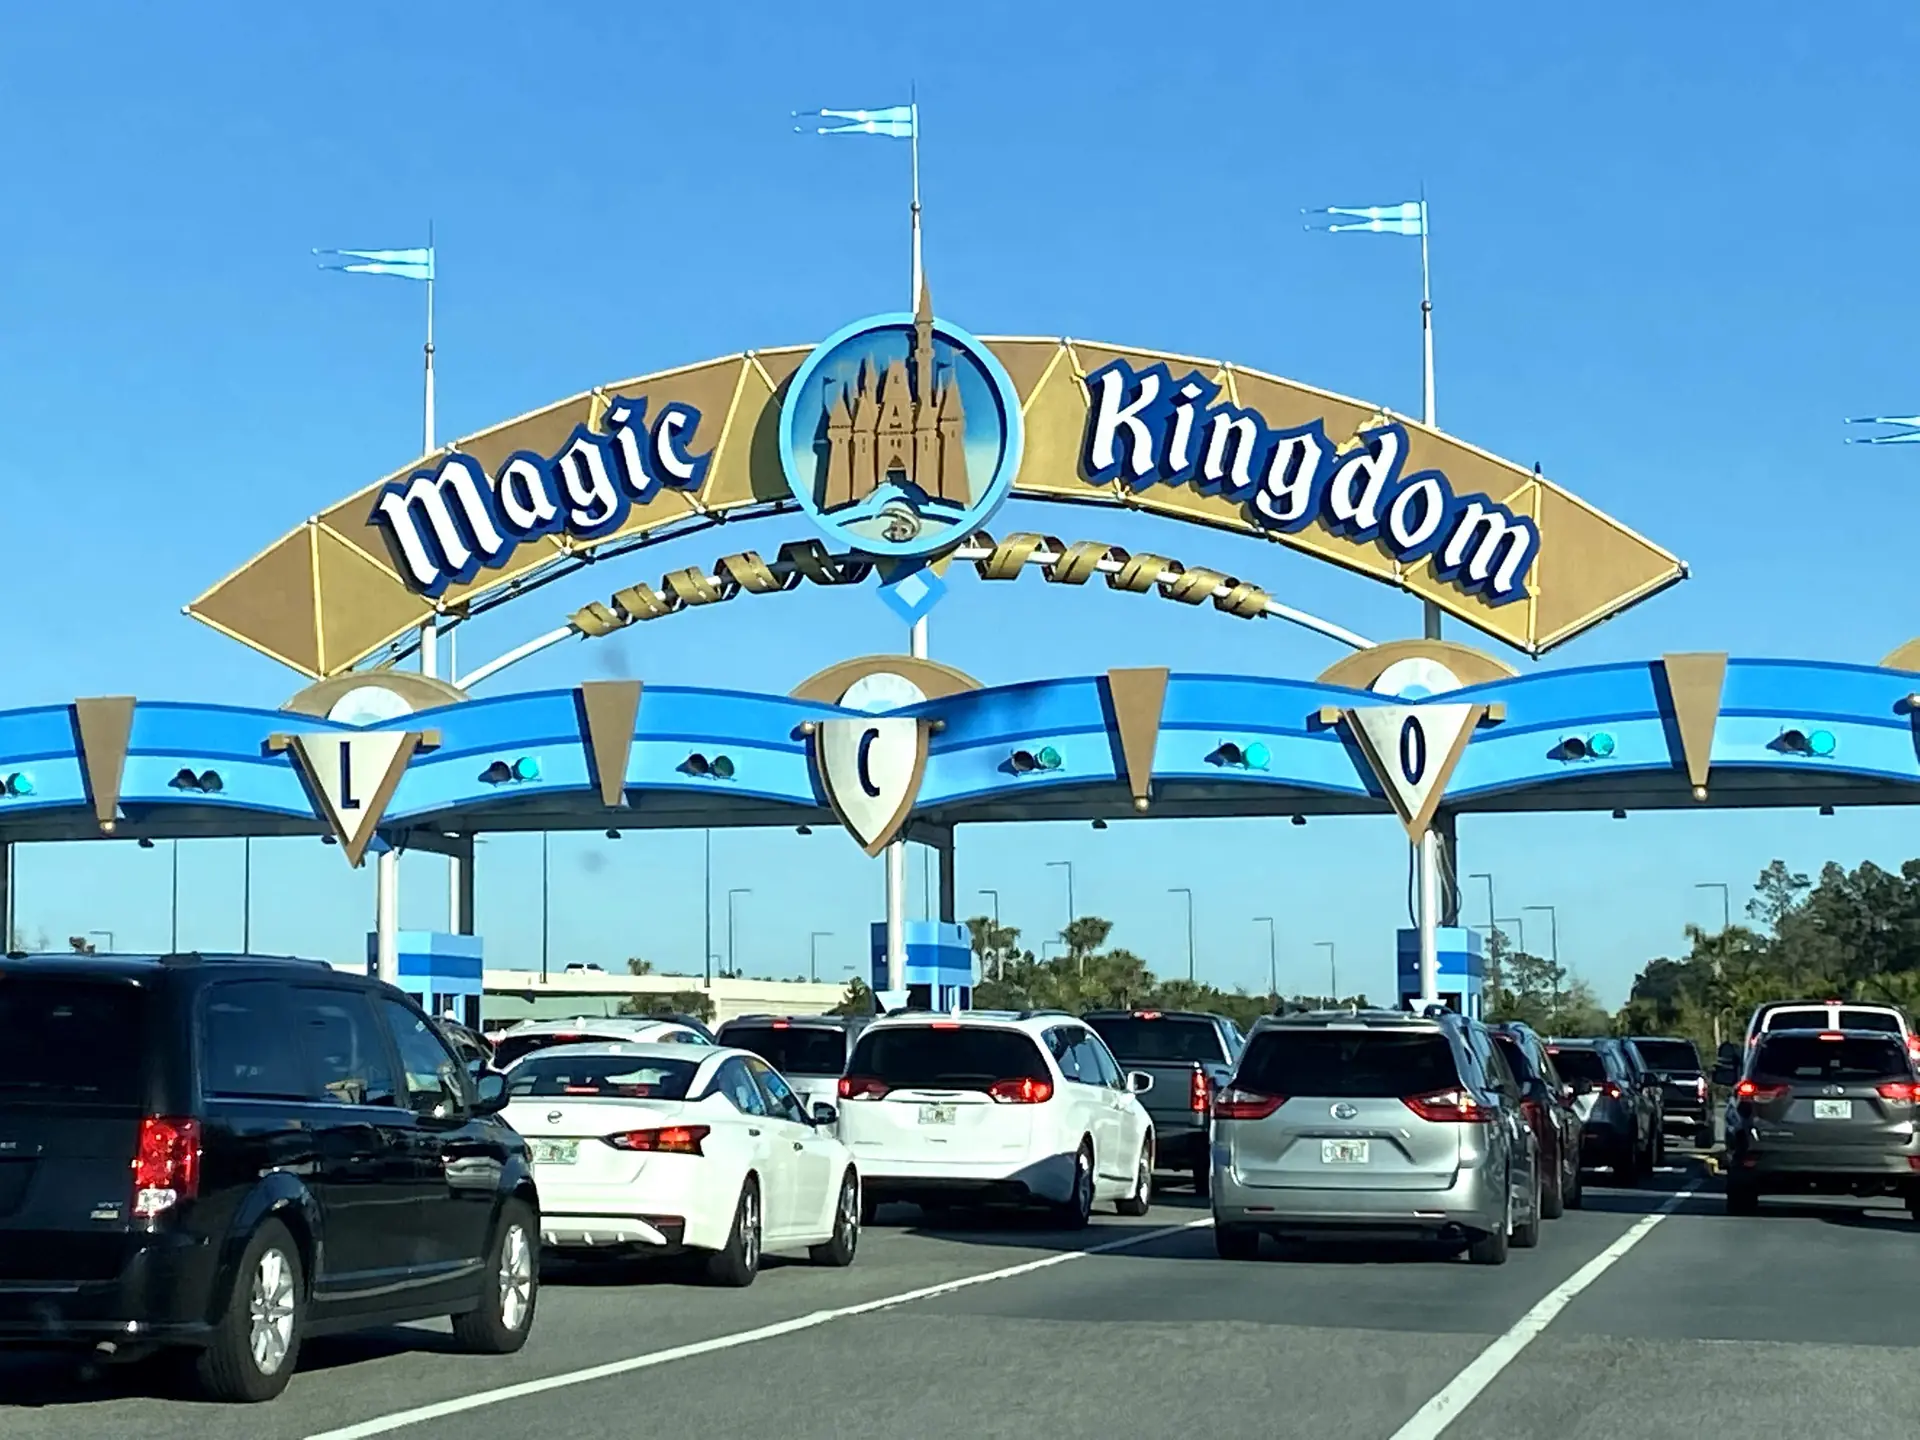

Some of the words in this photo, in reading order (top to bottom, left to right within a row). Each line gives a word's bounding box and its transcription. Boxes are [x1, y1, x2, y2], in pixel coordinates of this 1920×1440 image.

[375, 403, 701, 588] Magic
[1088, 365, 1543, 597] Kingdom
[339, 741, 361, 810] L
[857, 727, 881, 798] C
